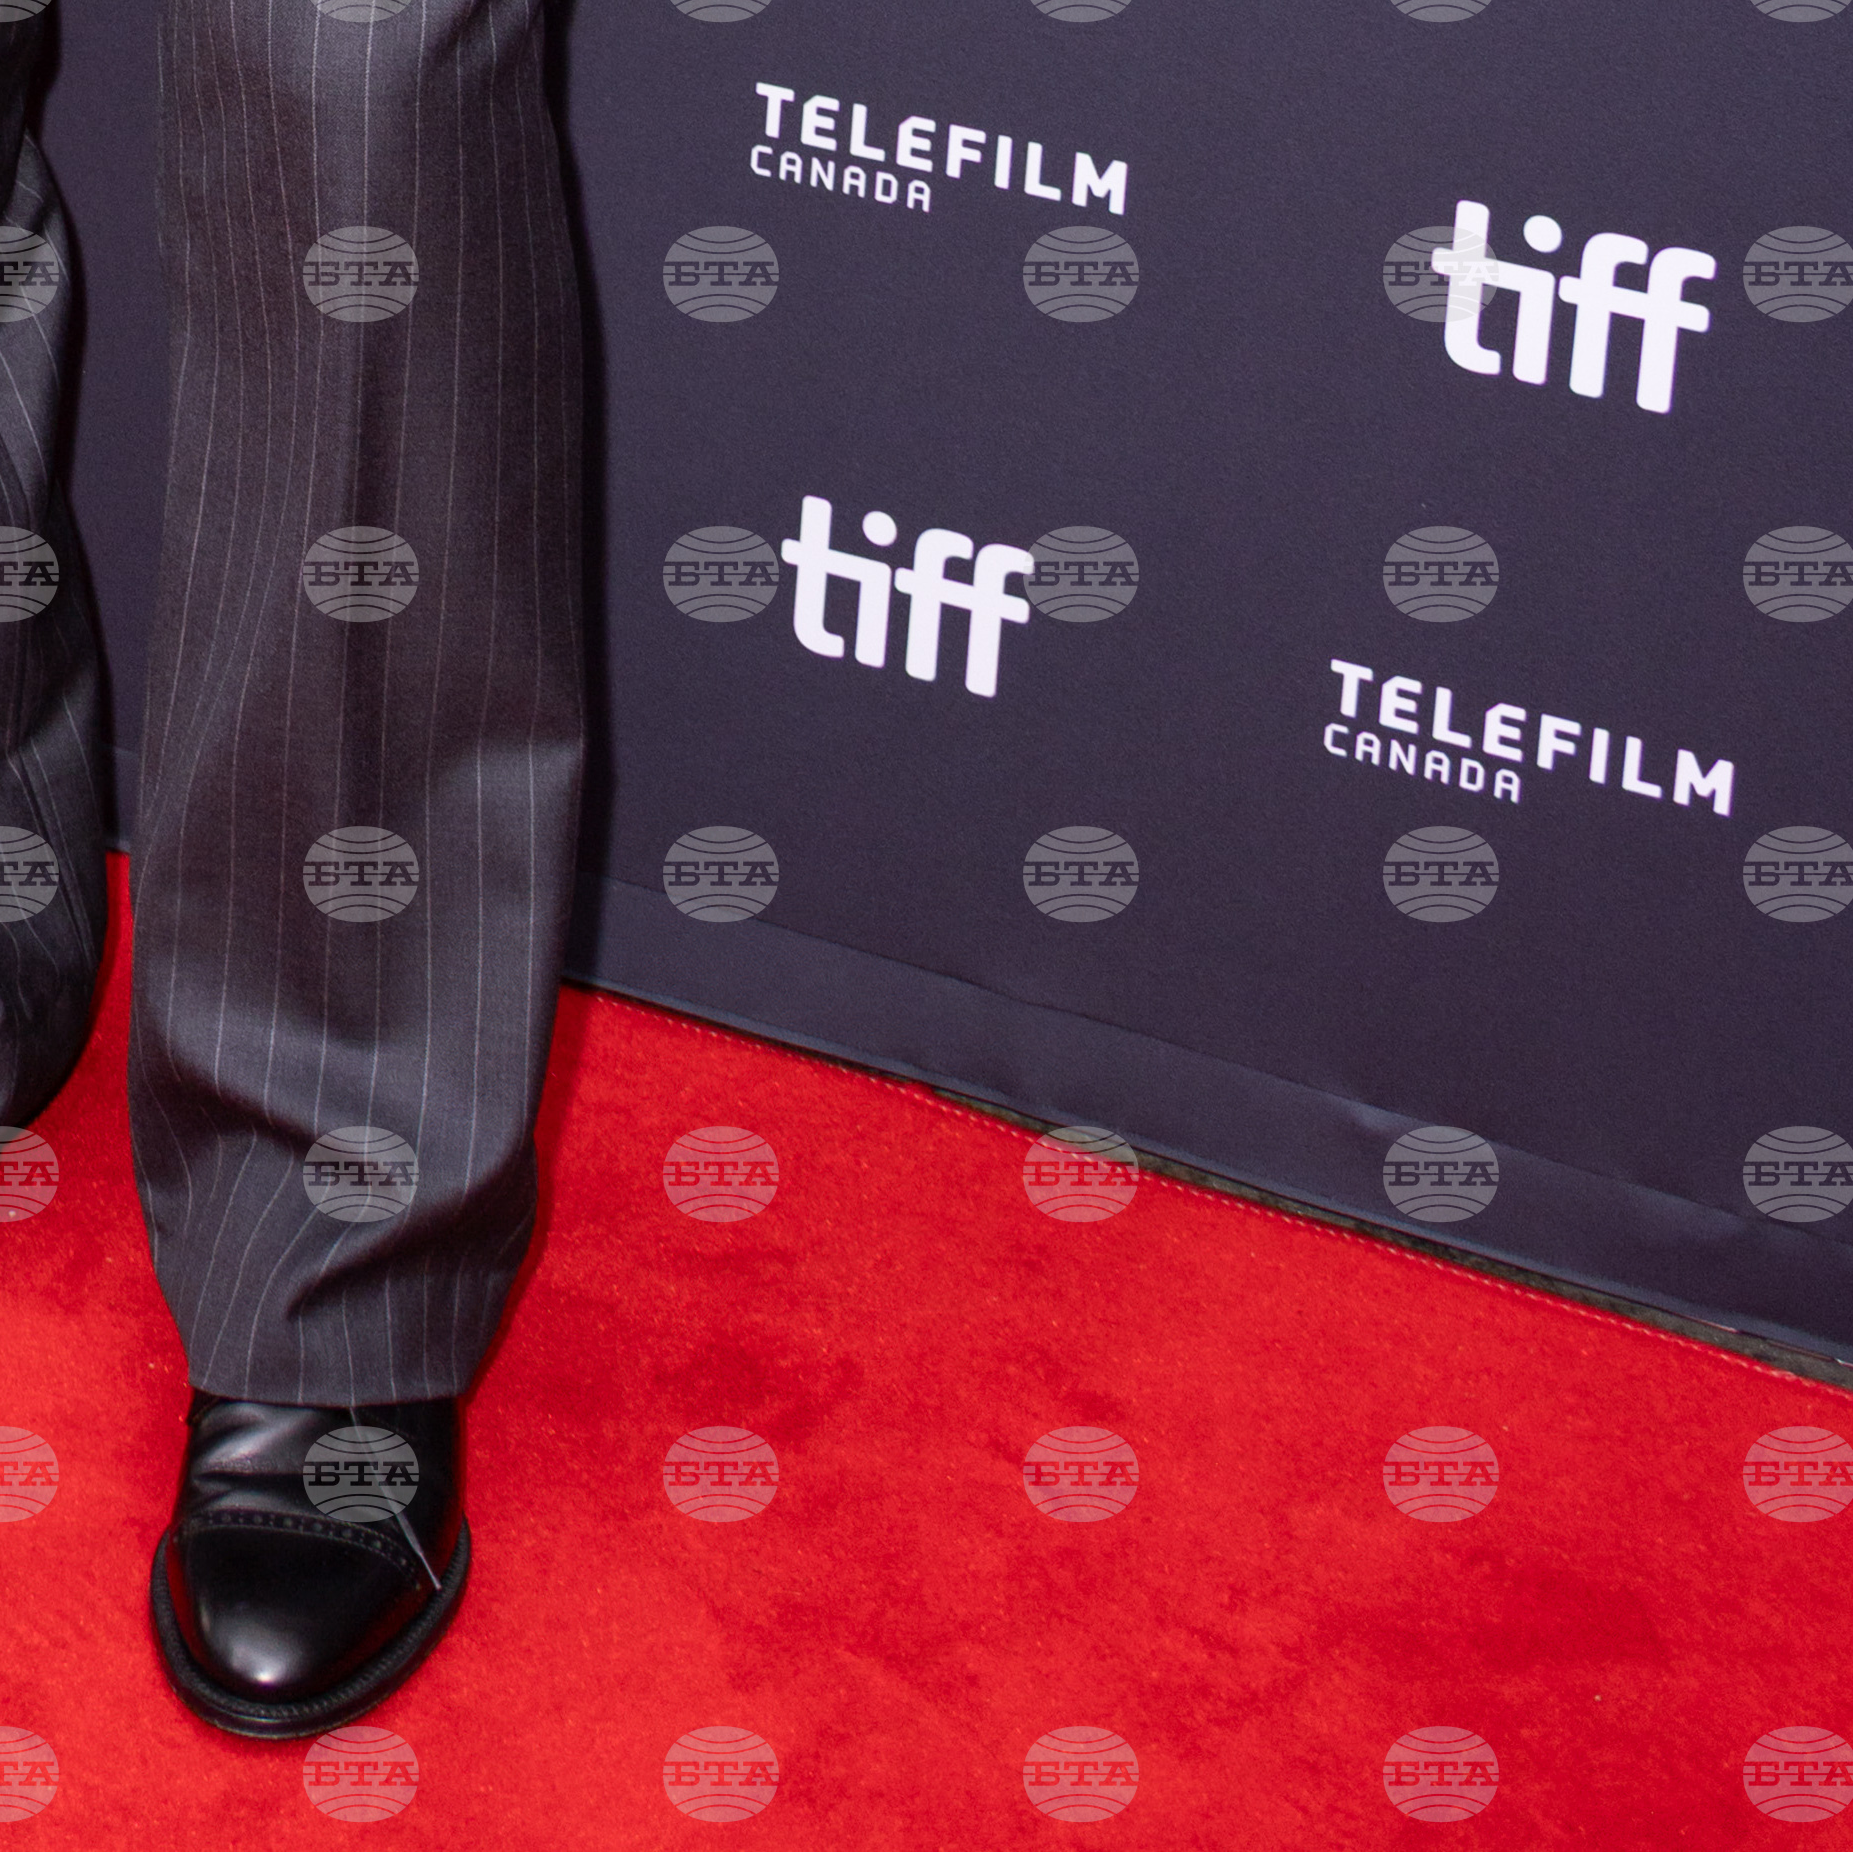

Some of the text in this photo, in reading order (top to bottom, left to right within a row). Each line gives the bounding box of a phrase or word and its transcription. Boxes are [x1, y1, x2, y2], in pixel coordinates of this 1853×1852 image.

[751, 146, 930, 211] CANADA
[756, 83, 1127, 214] TELEFILM
[1432, 201, 1715, 413] tiff
[782, 496, 1034, 696] tiff
[1325, 724, 1519, 802] CANADA
[1331, 660, 1733, 815] TELEFILM
